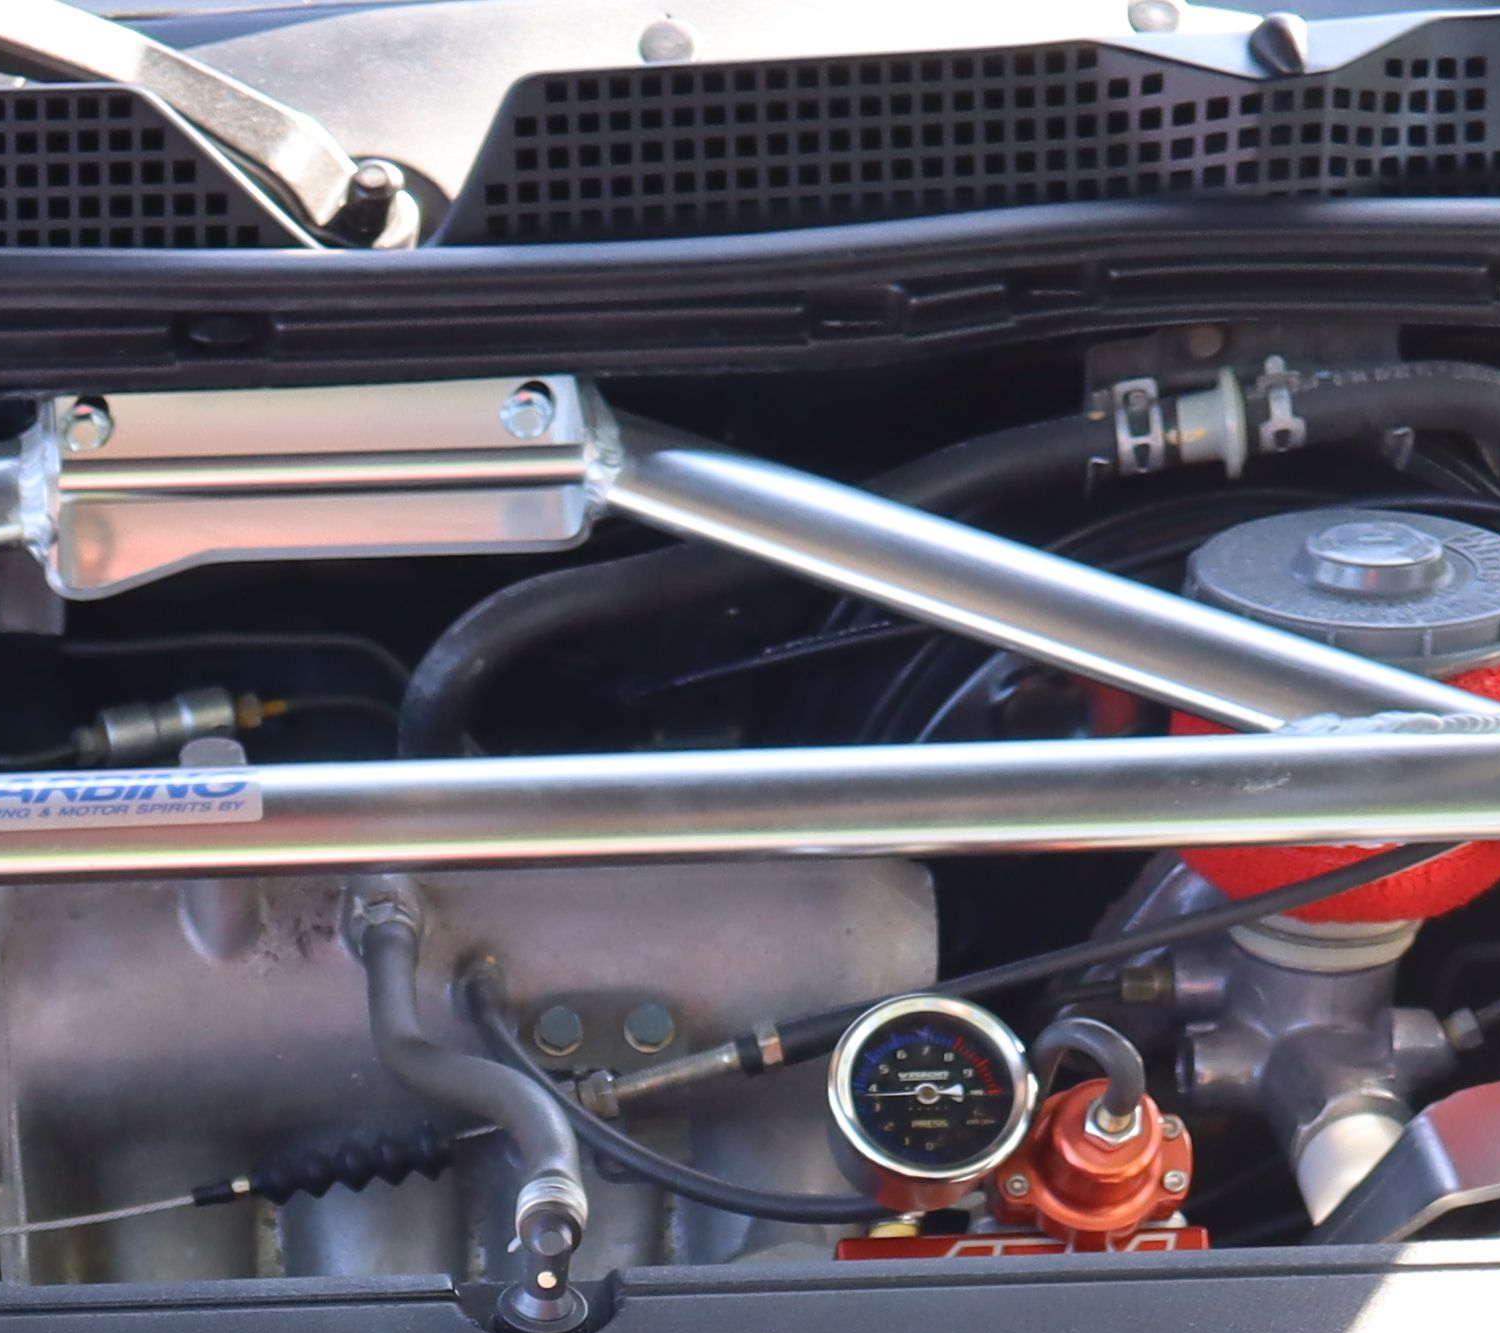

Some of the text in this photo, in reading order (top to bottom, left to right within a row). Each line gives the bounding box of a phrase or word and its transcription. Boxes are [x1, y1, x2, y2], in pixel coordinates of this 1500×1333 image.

[39, 806, 52, 818] &
[58, 803, 128, 818] MOTOR
[136, 801, 212, 816] SPIRITS
[217, 800, 246, 812] BY
